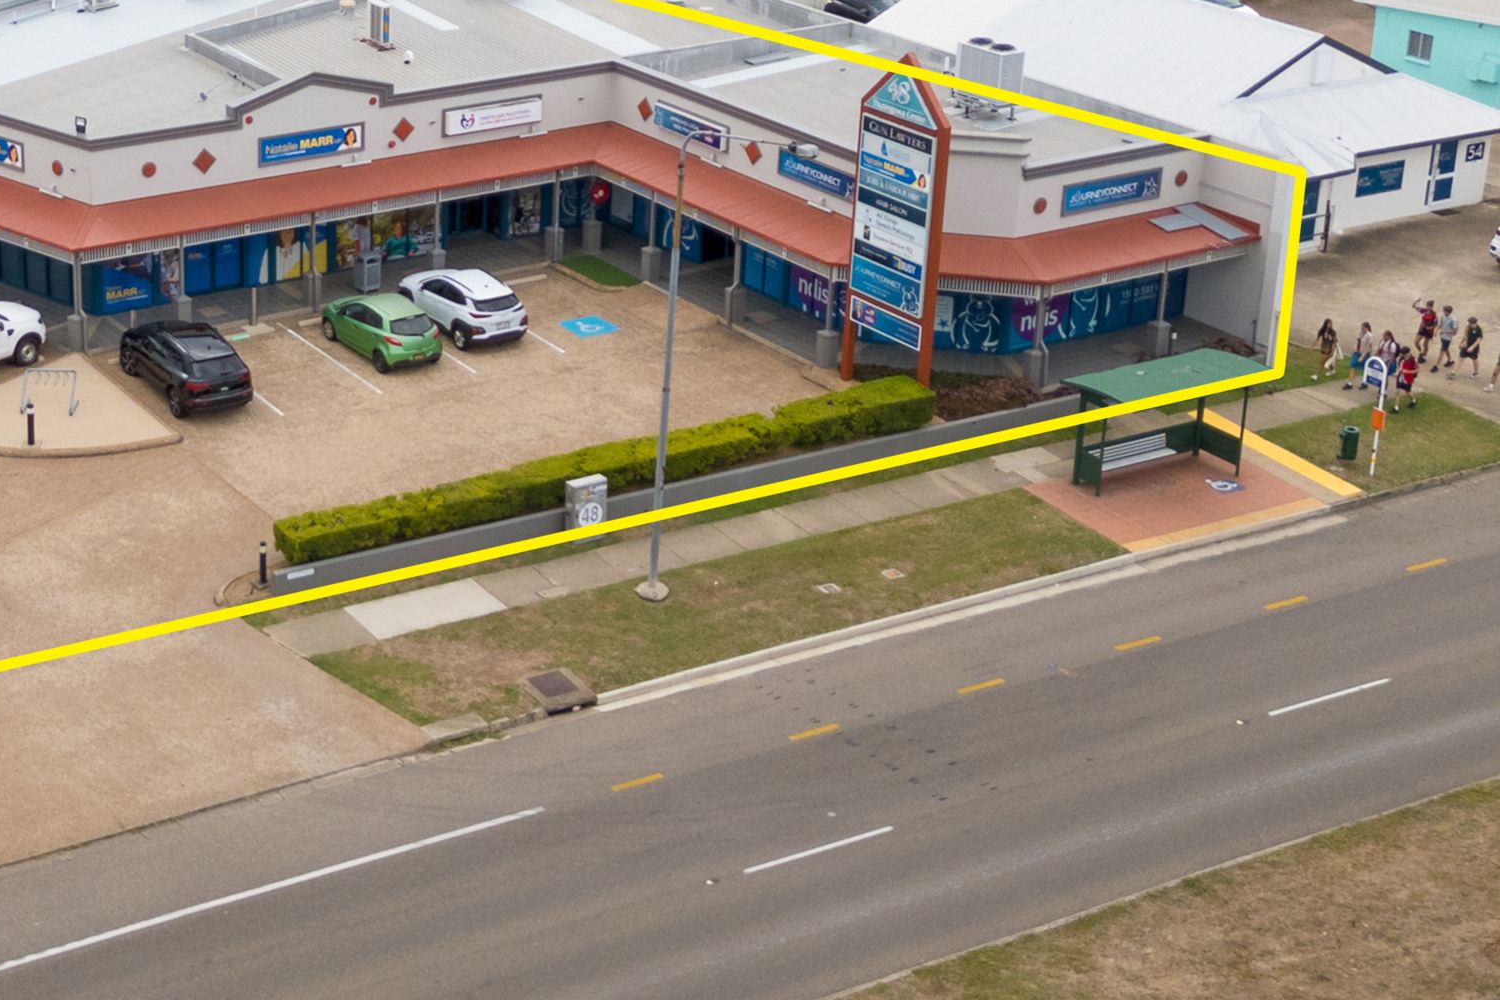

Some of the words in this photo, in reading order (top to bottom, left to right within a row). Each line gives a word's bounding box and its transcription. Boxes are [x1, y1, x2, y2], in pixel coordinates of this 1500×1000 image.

[887, 78, 911, 105] 48
[265, 142, 298, 155] Natalie
[299, 135, 334, 149] MARR
[1467, 145, 1484, 161] 54
[105, 286, 138, 300] MARR
[581, 504, 600, 523] 48
